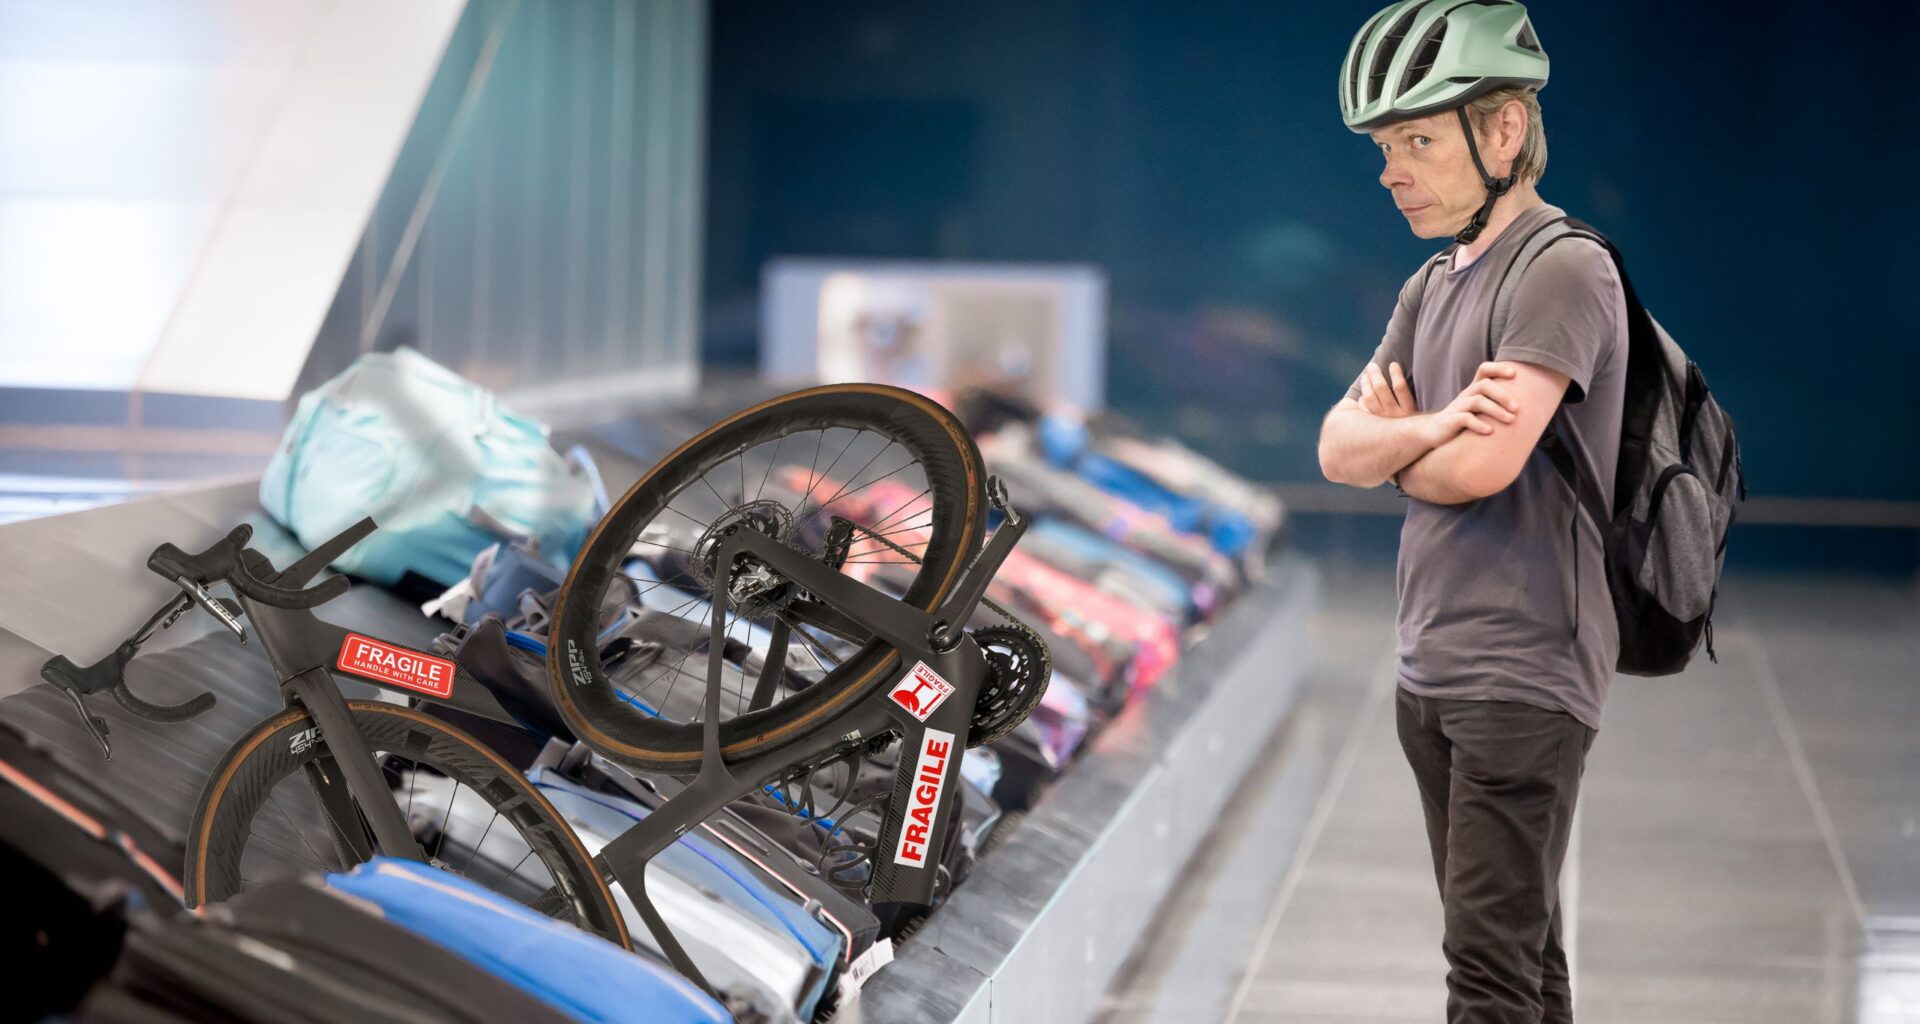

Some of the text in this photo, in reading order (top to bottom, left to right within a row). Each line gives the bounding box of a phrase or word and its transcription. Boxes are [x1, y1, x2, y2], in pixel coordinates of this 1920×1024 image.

[353, 659, 440, 689] HANDLE WITH CARE
[356, 643, 442, 681] FRAGILE
[567, 639, 587, 686] ZIPP
[917, 665, 949, 694] FRAGILE
[901, 739, 949, 862] FRAGILE
